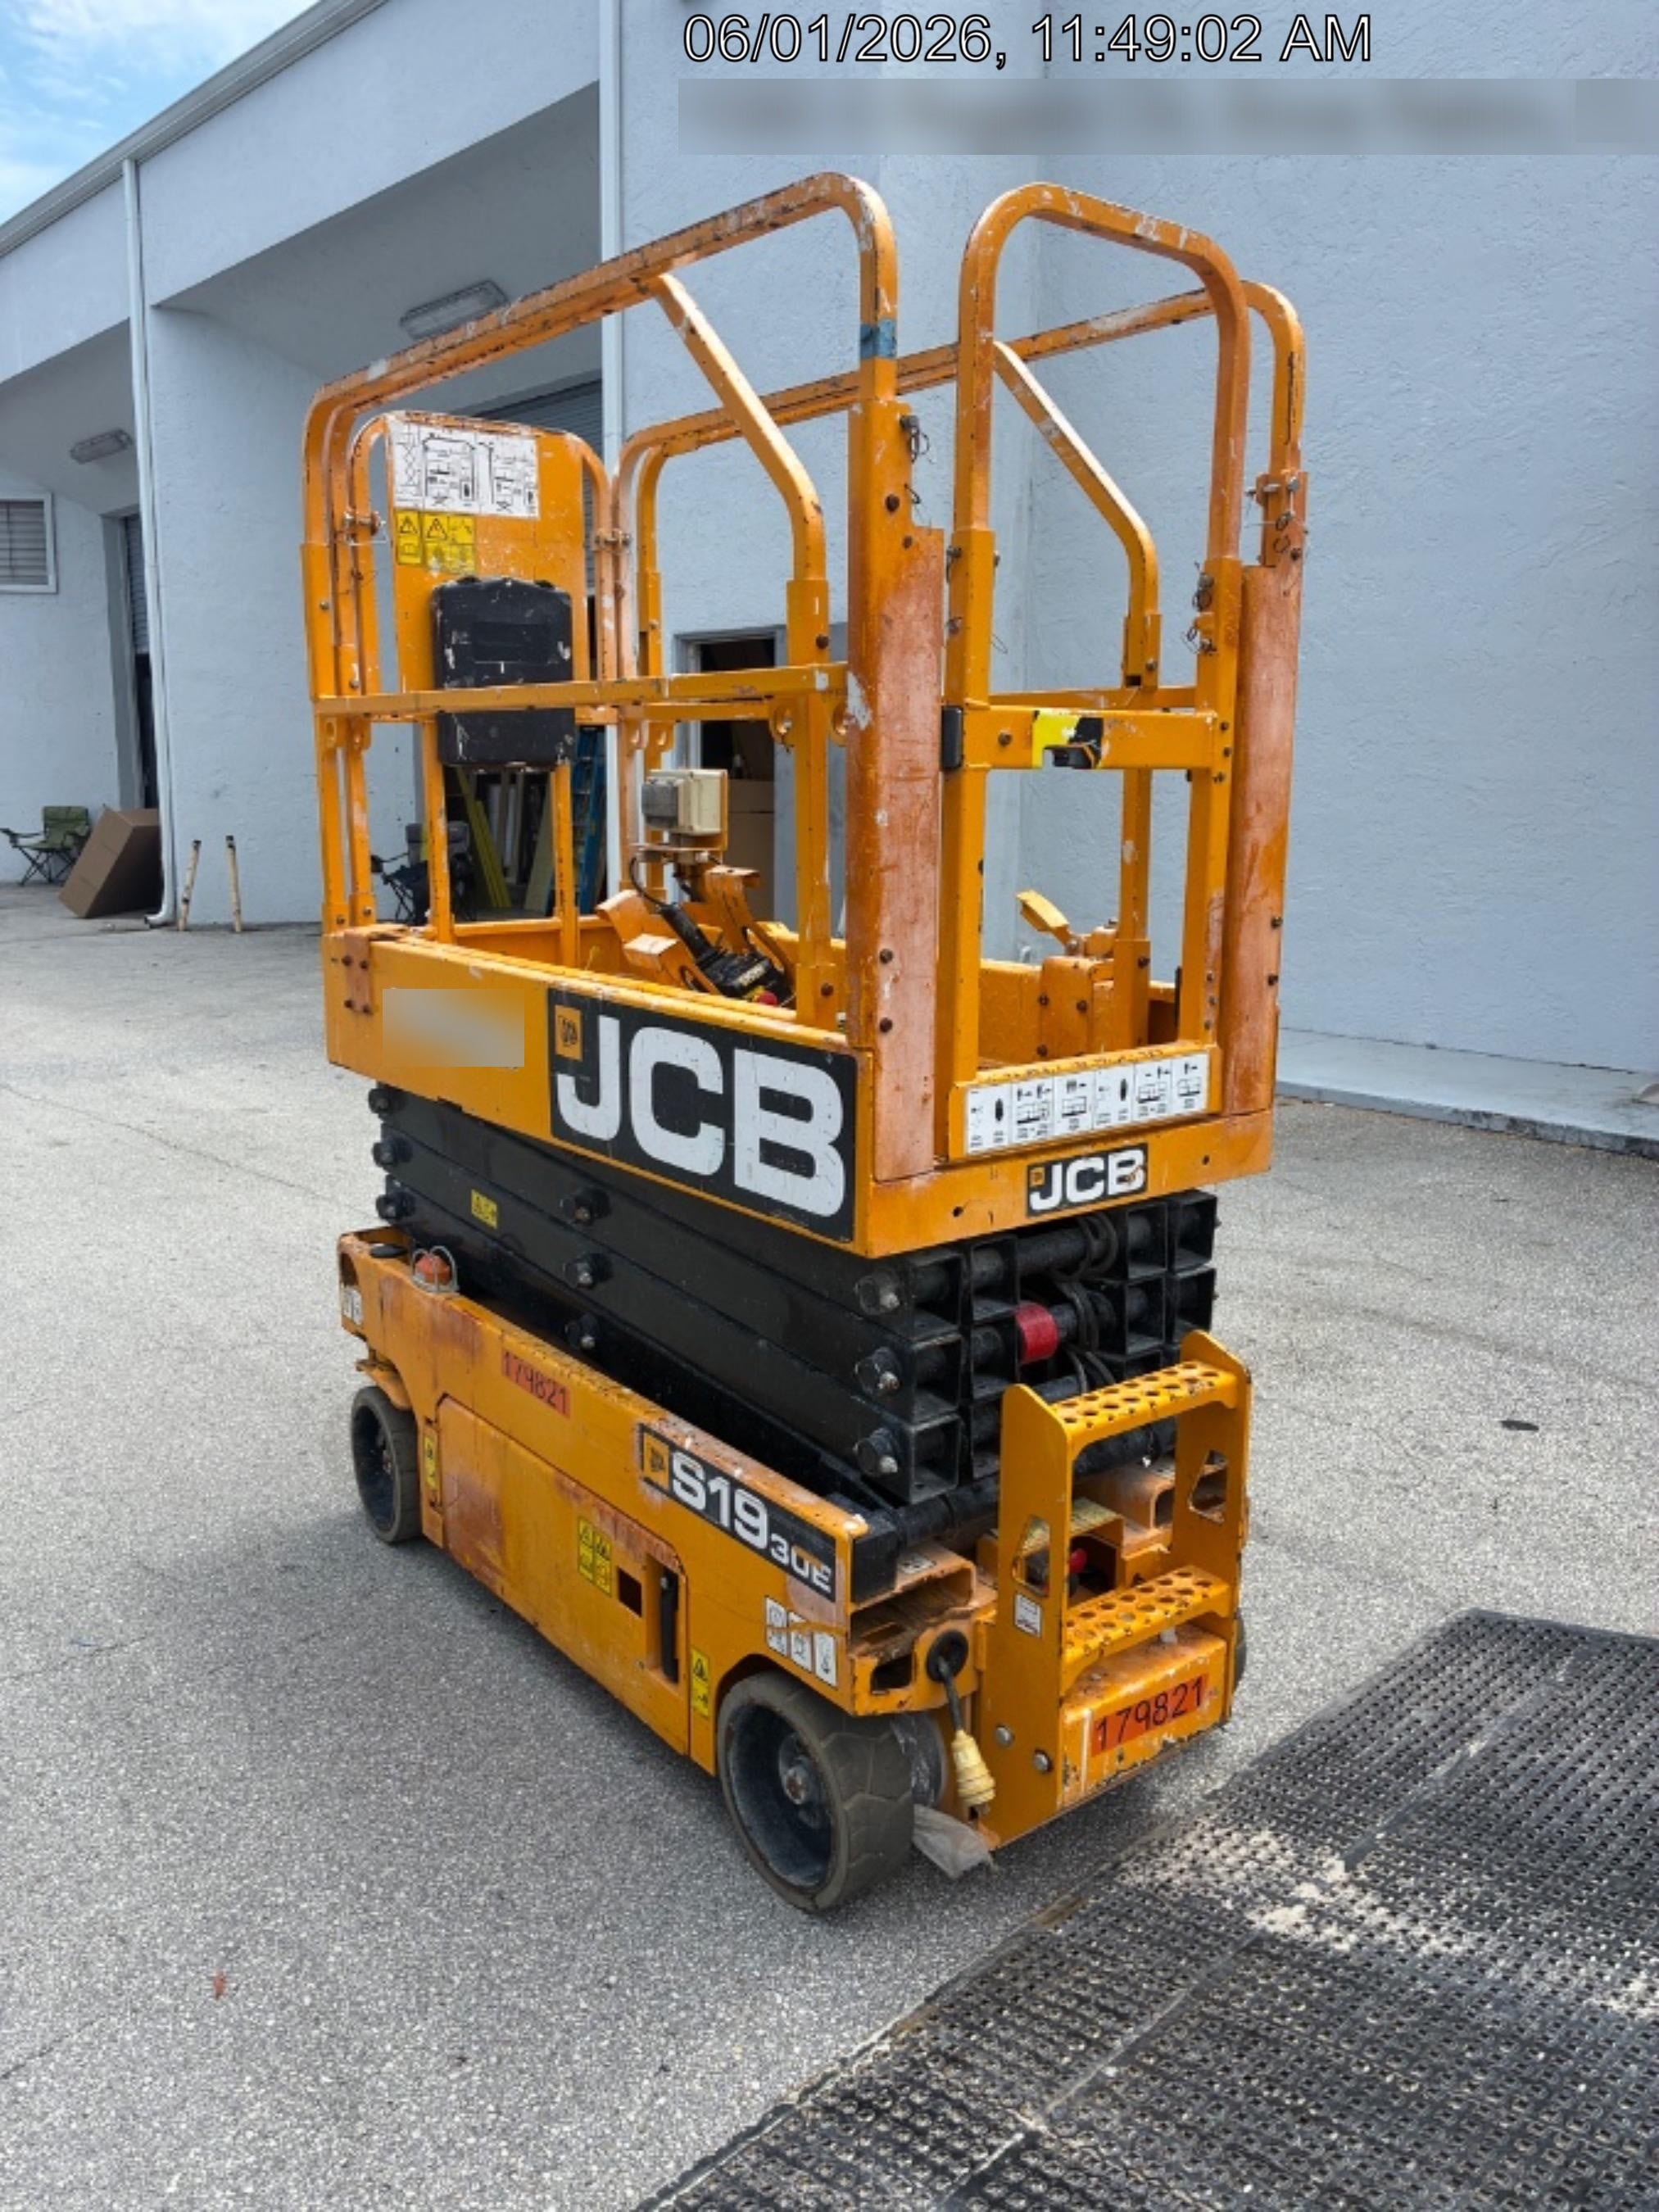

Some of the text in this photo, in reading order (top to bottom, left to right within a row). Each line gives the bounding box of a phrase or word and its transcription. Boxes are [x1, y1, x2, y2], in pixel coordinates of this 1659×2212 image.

[557, 1015, 845, 1217] JCB
[1030, 1149, 1145, 1211] JCB
[504, 1350, 567, 1415] 179821
[1095, 1675, 1204, 1750] 179821
